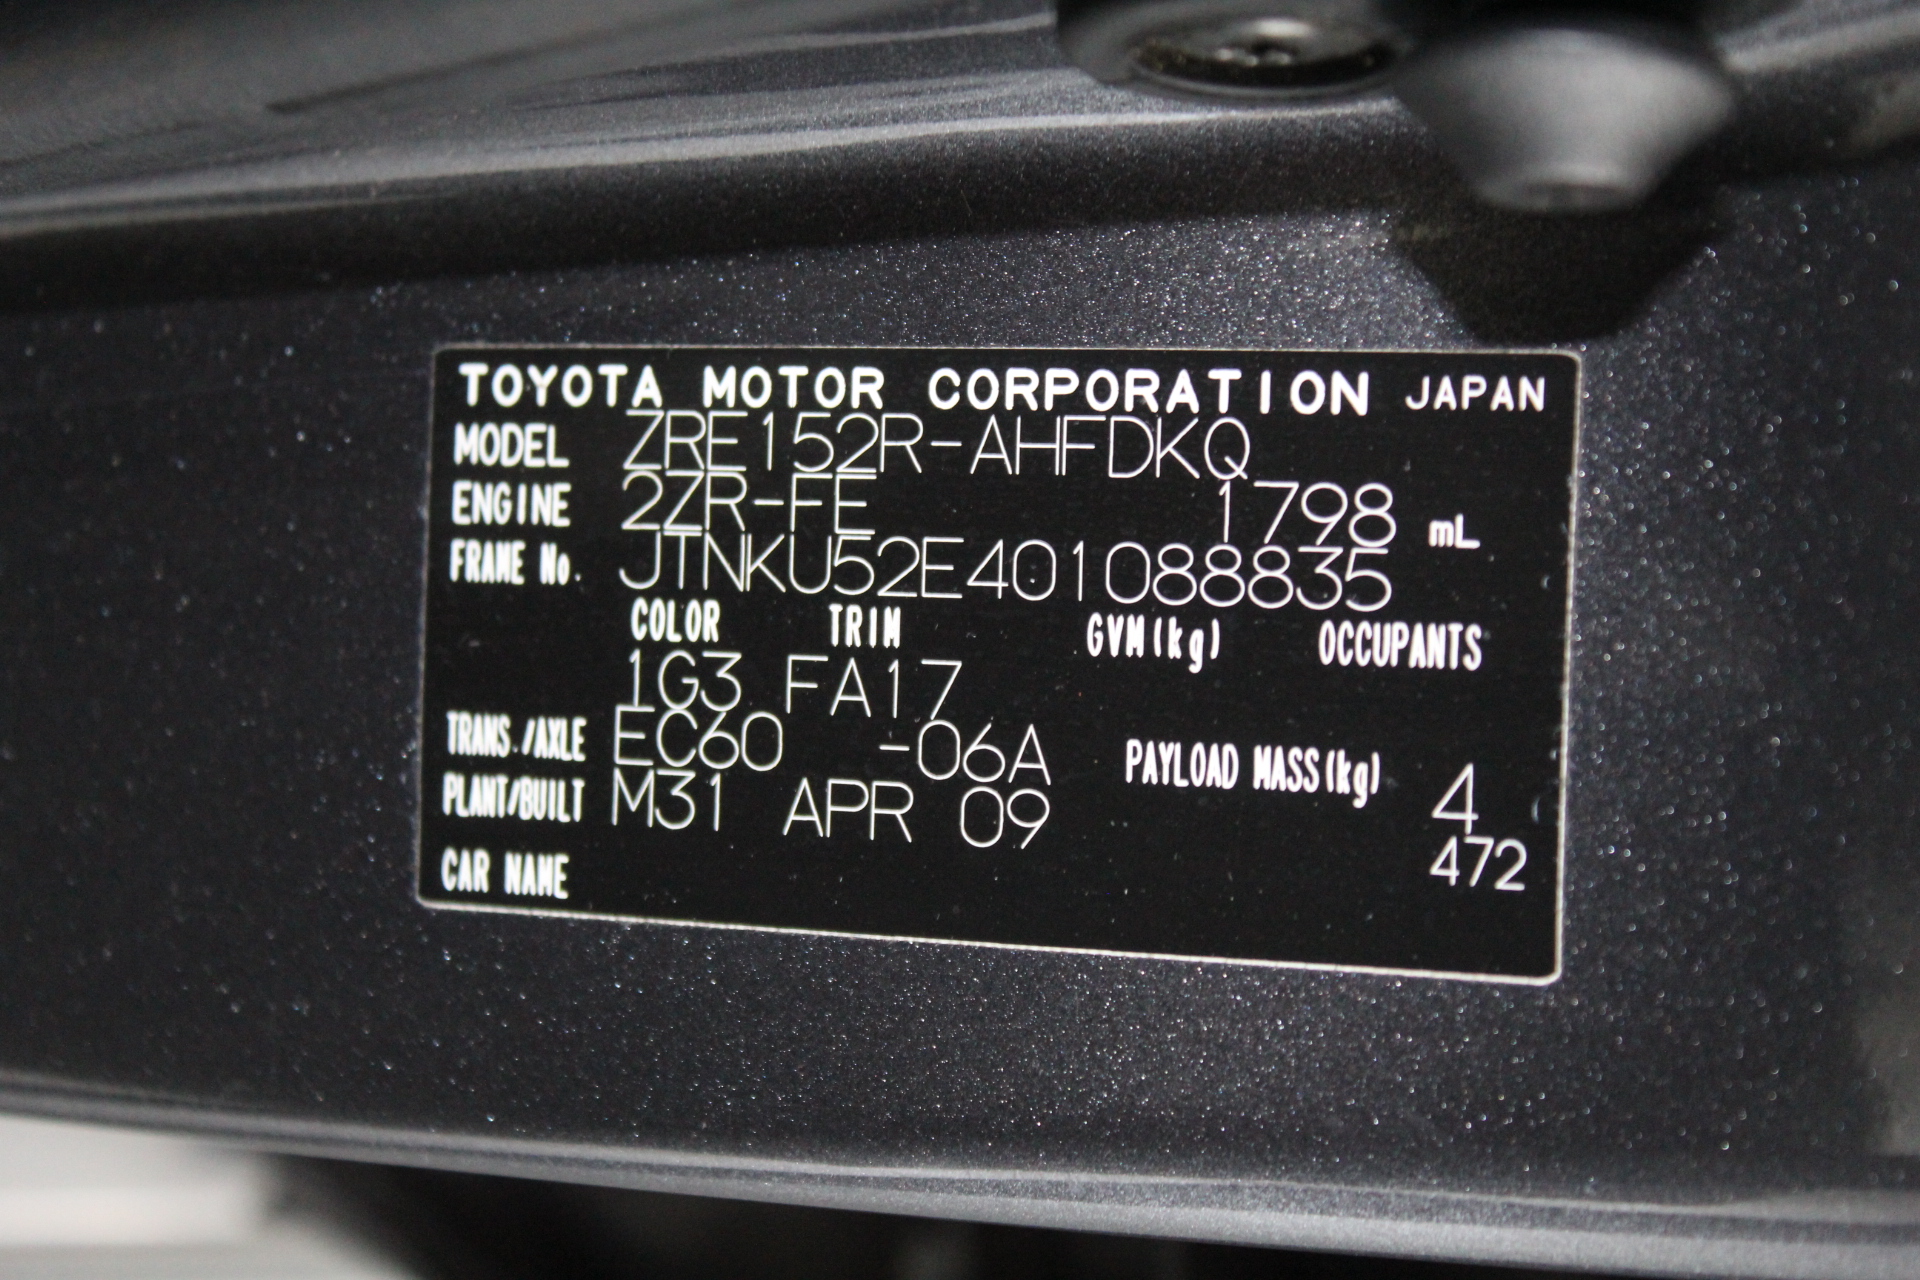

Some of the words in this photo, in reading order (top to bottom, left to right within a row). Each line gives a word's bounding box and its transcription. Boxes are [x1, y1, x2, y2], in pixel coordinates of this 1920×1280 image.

[459, 363, 662, 408] TOYOTA
[703, 366, 884, 410] MOTOR
[928, 367, 1370, 416] CORPORATION
[1405, 375, 1546, 412] JAPAN
[454, 422, 569, 468] MODEL
[623, 409, 1251, 480] ZRE152R-AHFDKQ
[451, 481, 571, 527] ENGINE
[621, 469, 878, 535] 2ZR-FE
[1218, 480, 1397, 547] 1798
[1428, 514, 1480, 549] mL
[450, 540, 525, 586] FRAME
[540, 542, 582, 586] No.
[619, 531, 1392, 612] JTNKU52E401088835
[630, 597, 721, 643] COLOR
[830, 603, 901, 648] TRIM
[1318, 619, 1483, 672] OCCUPANTS
[629, 649, 742, 712] 1G3
[786, 655, 962, 720] FA17
[613, 705, 783, 771] EC60
[1125, 738, 1240, 790] PAYLOAD
[442, 772, 585, 823] PLANT/BUILT
[611, 768, 721, 831] M31
[782, 776, 914, 843] APR
[960, 786, 1051, 849] 09
[1431, 762, 1479, 835] 4
[441, 848, 489, 894] CAR
[504, 853, 569, 900] NAME
[1429, 835, 1528, 892] 472
